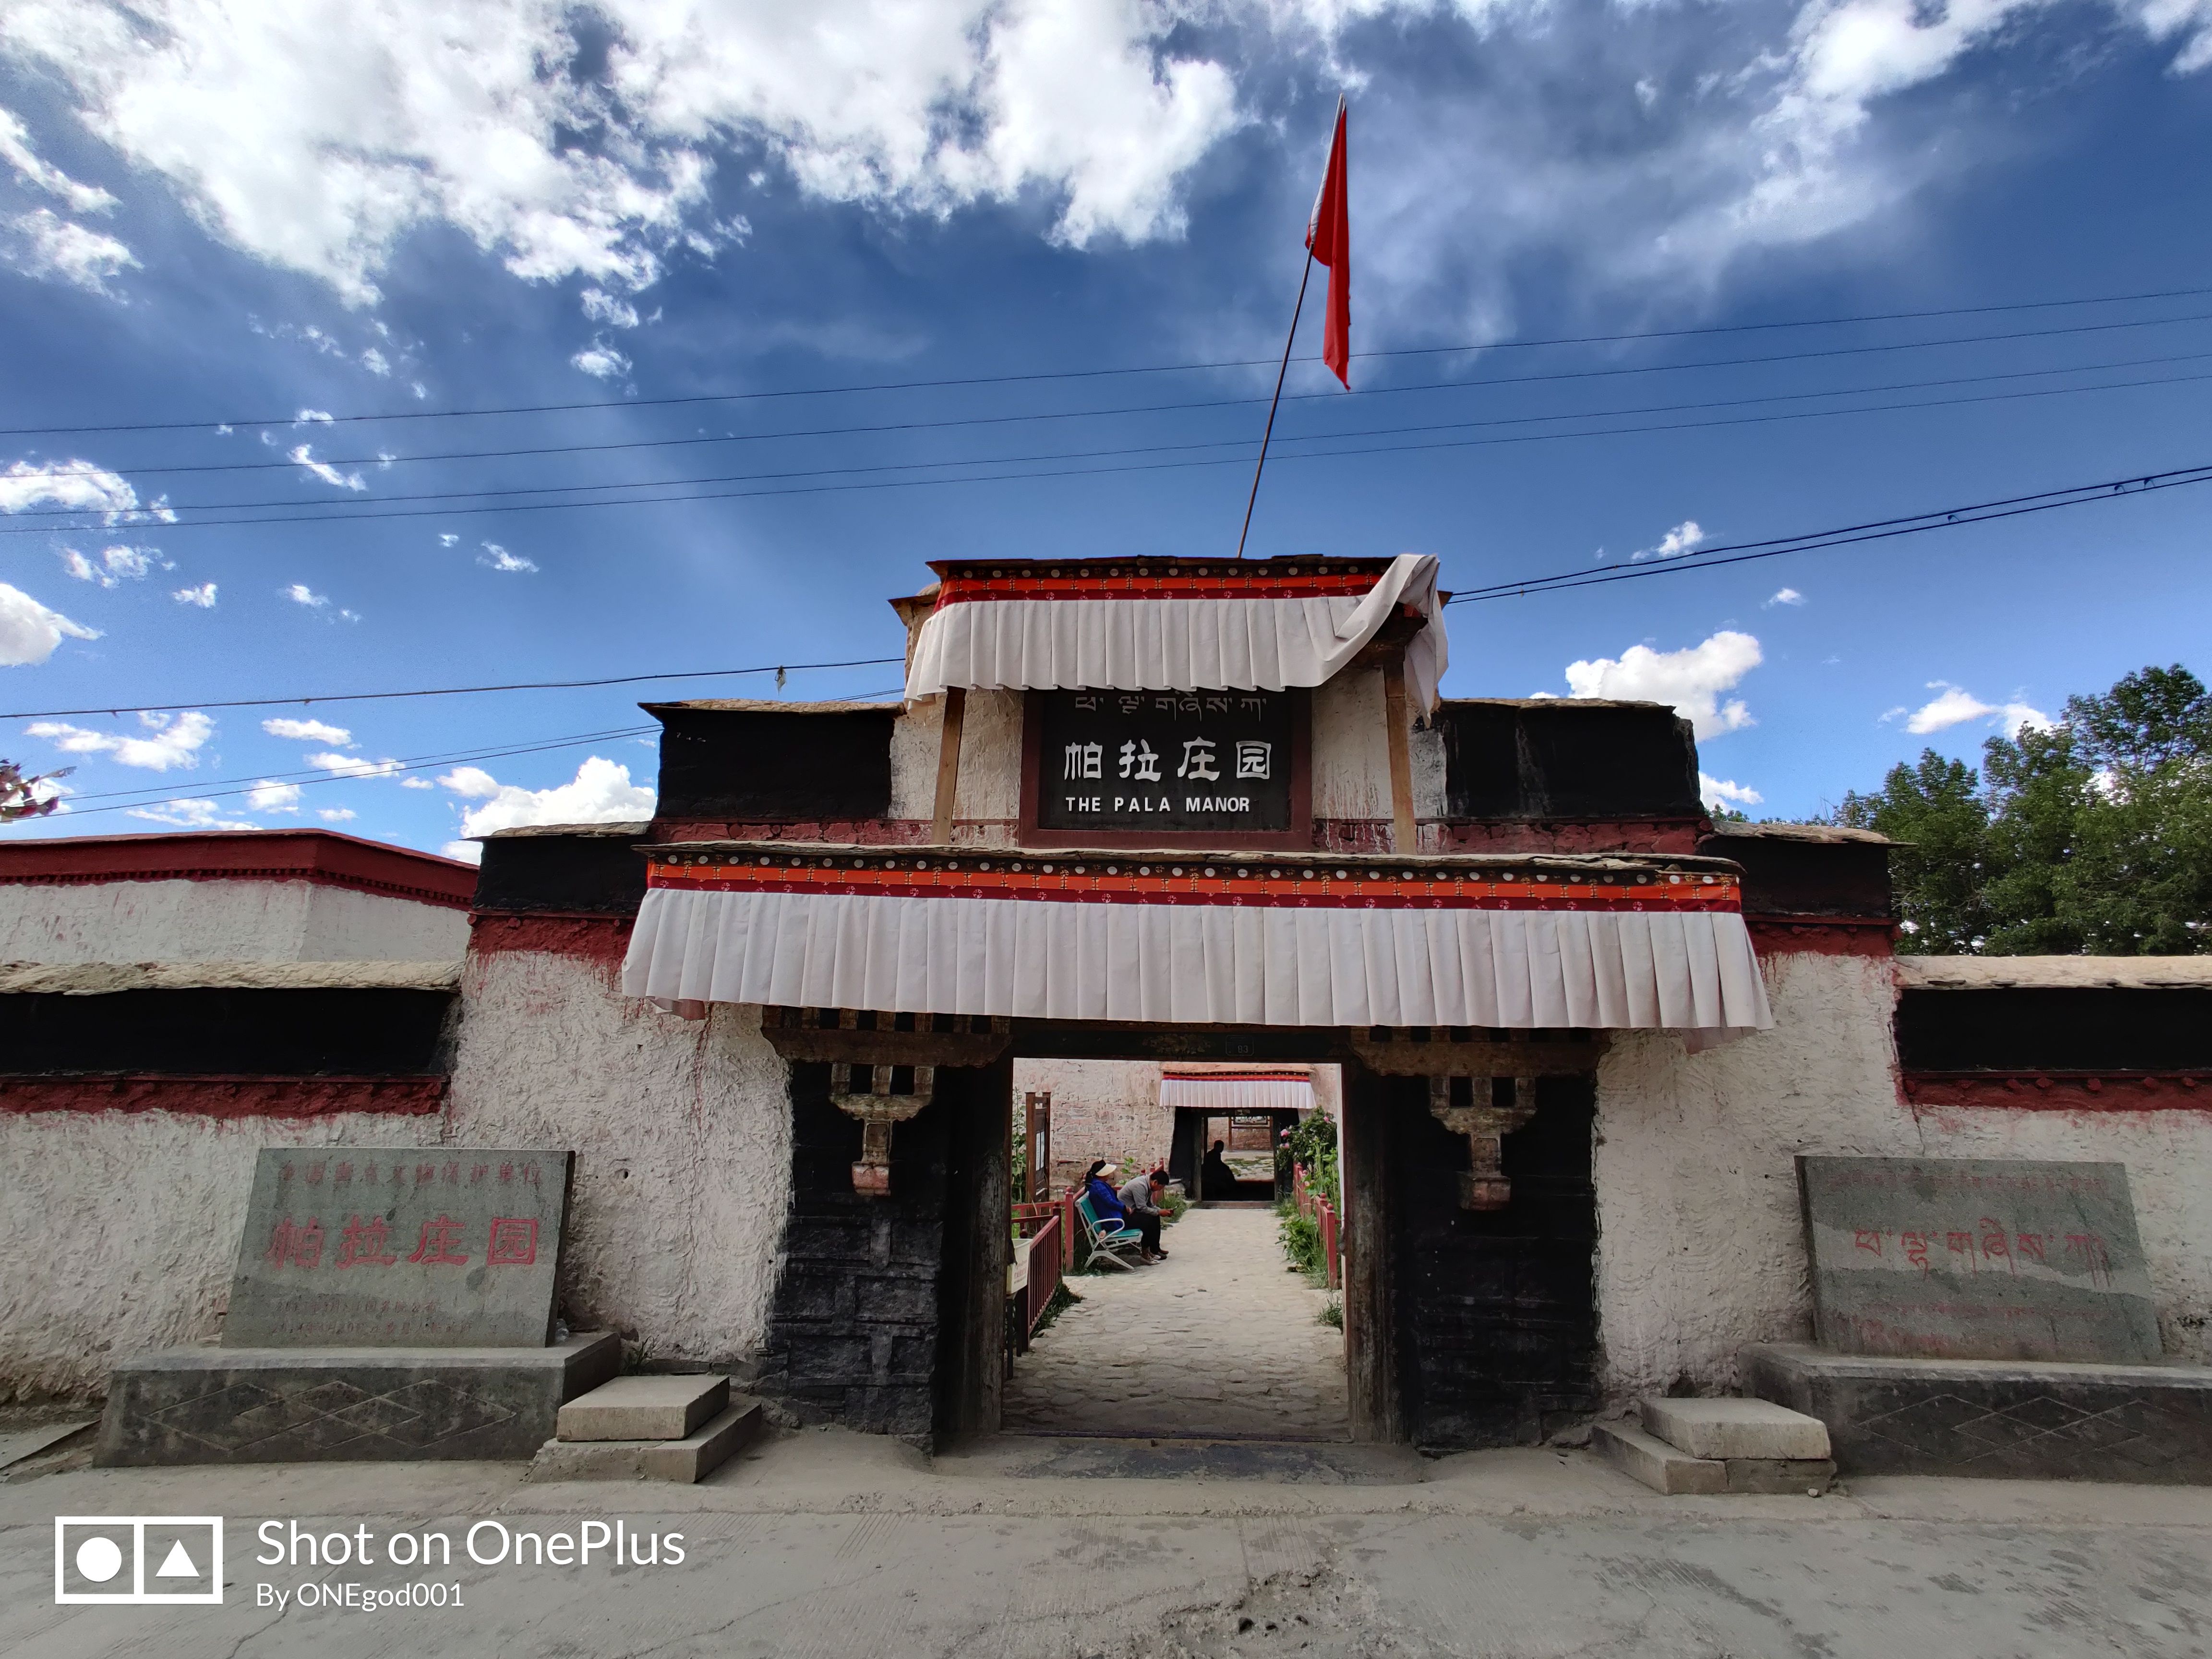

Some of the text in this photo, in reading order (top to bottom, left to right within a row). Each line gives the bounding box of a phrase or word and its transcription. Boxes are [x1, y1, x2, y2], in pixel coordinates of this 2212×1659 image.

[1064, 736, 1272, 782] 帕拉庄园
[1065, 797, 1250, 812] THE PALA MANOR
[264, 1214, 538, 1269] 帕拉庄园
